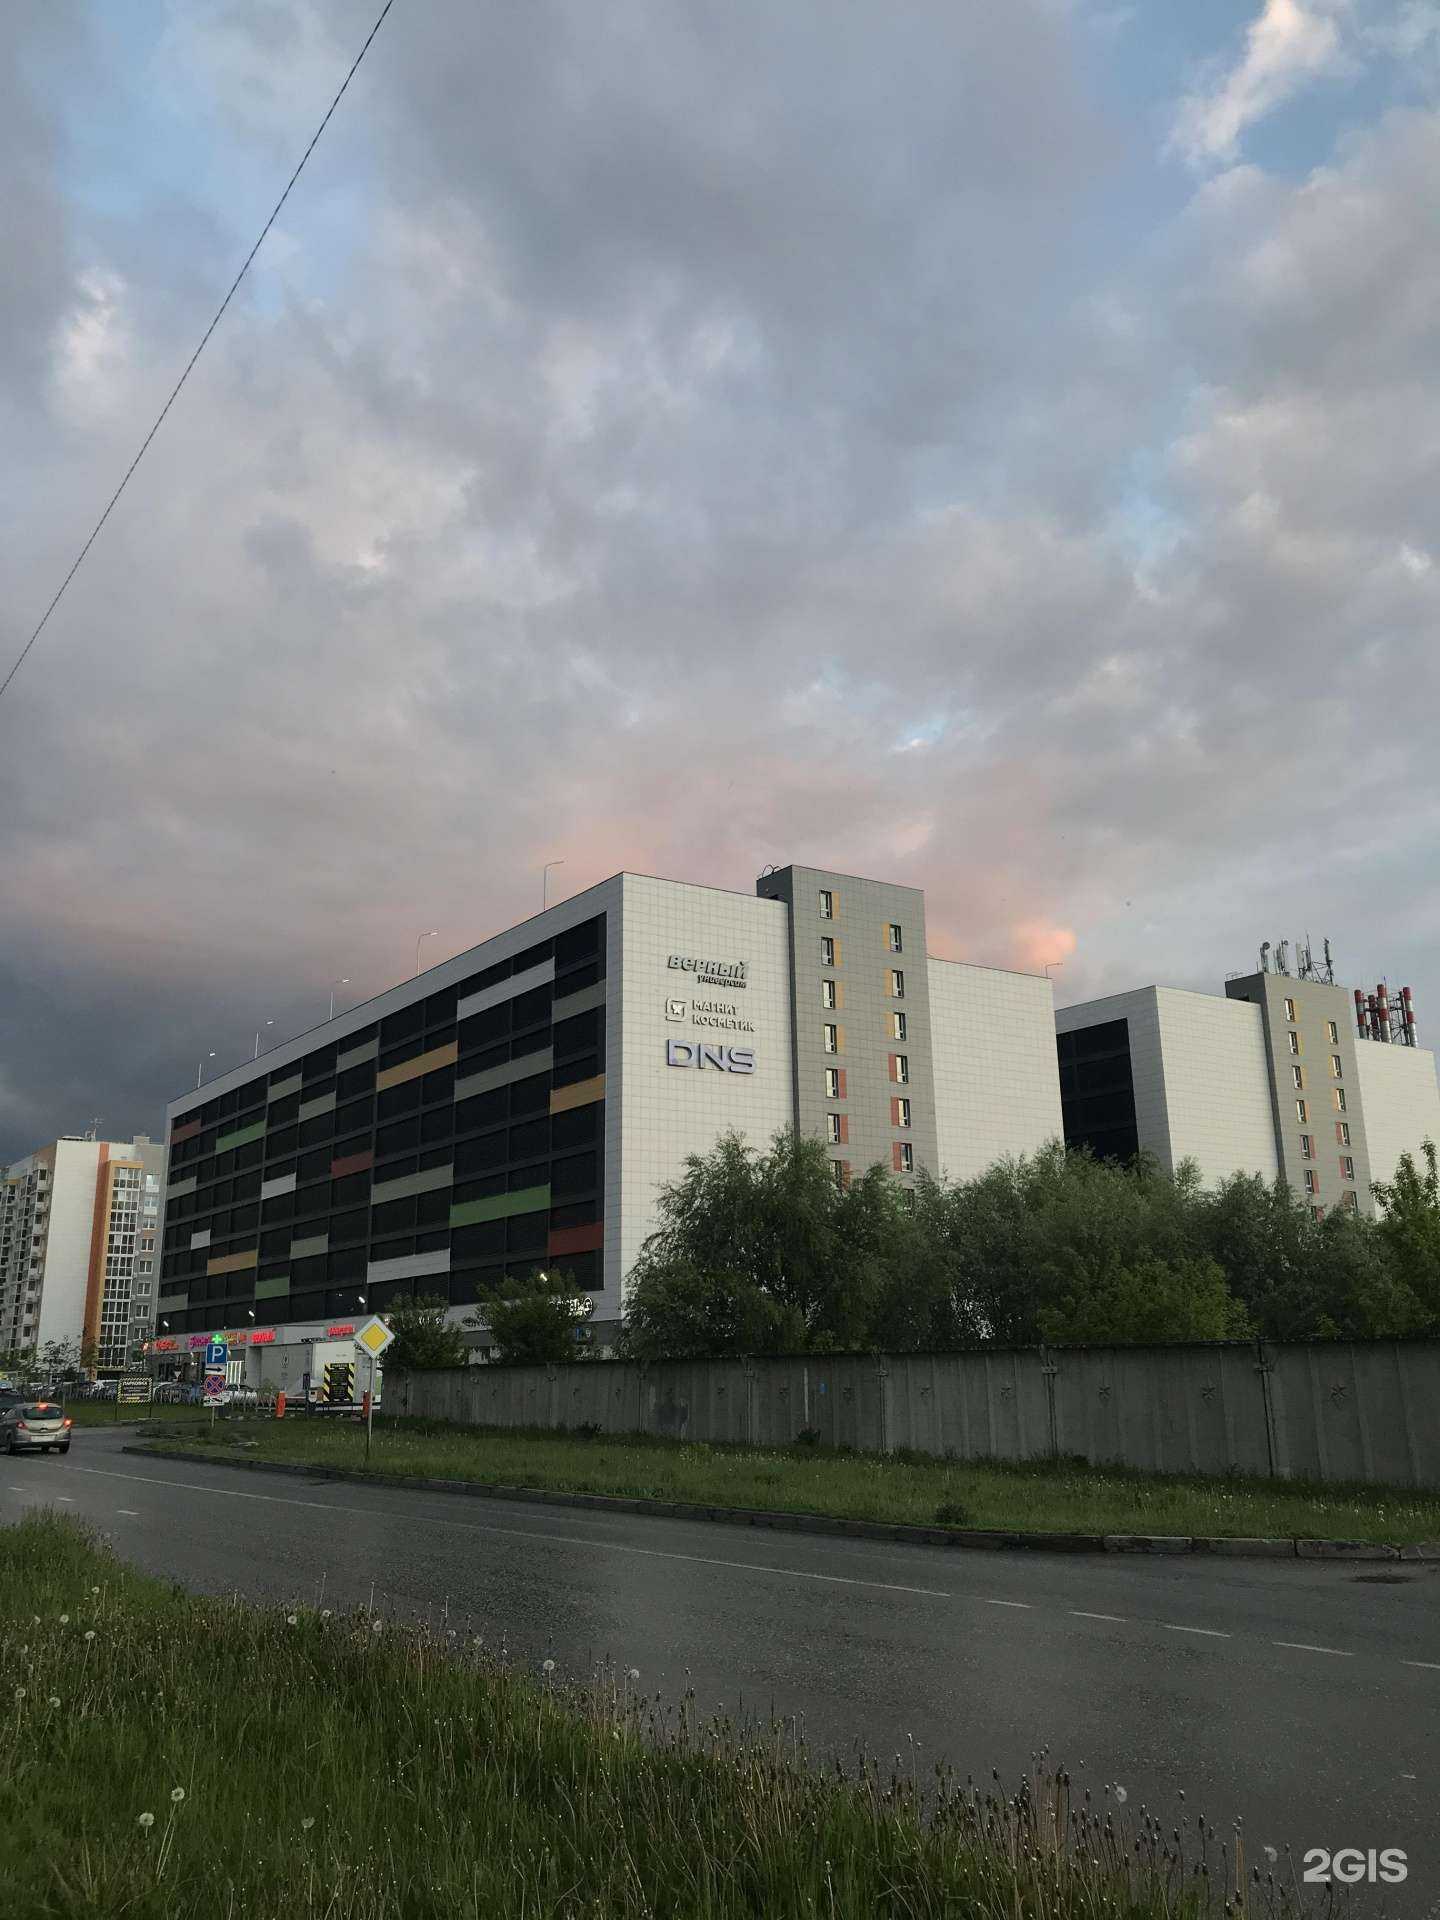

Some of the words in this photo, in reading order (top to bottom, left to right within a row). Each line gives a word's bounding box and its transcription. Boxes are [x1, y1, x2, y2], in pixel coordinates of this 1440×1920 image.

[692, 999, 738, 1016] МАГНИТ
[692, 1014, 756, 1032] КОСМЕТИК
[667, 1039, 757, 1074] DNS
